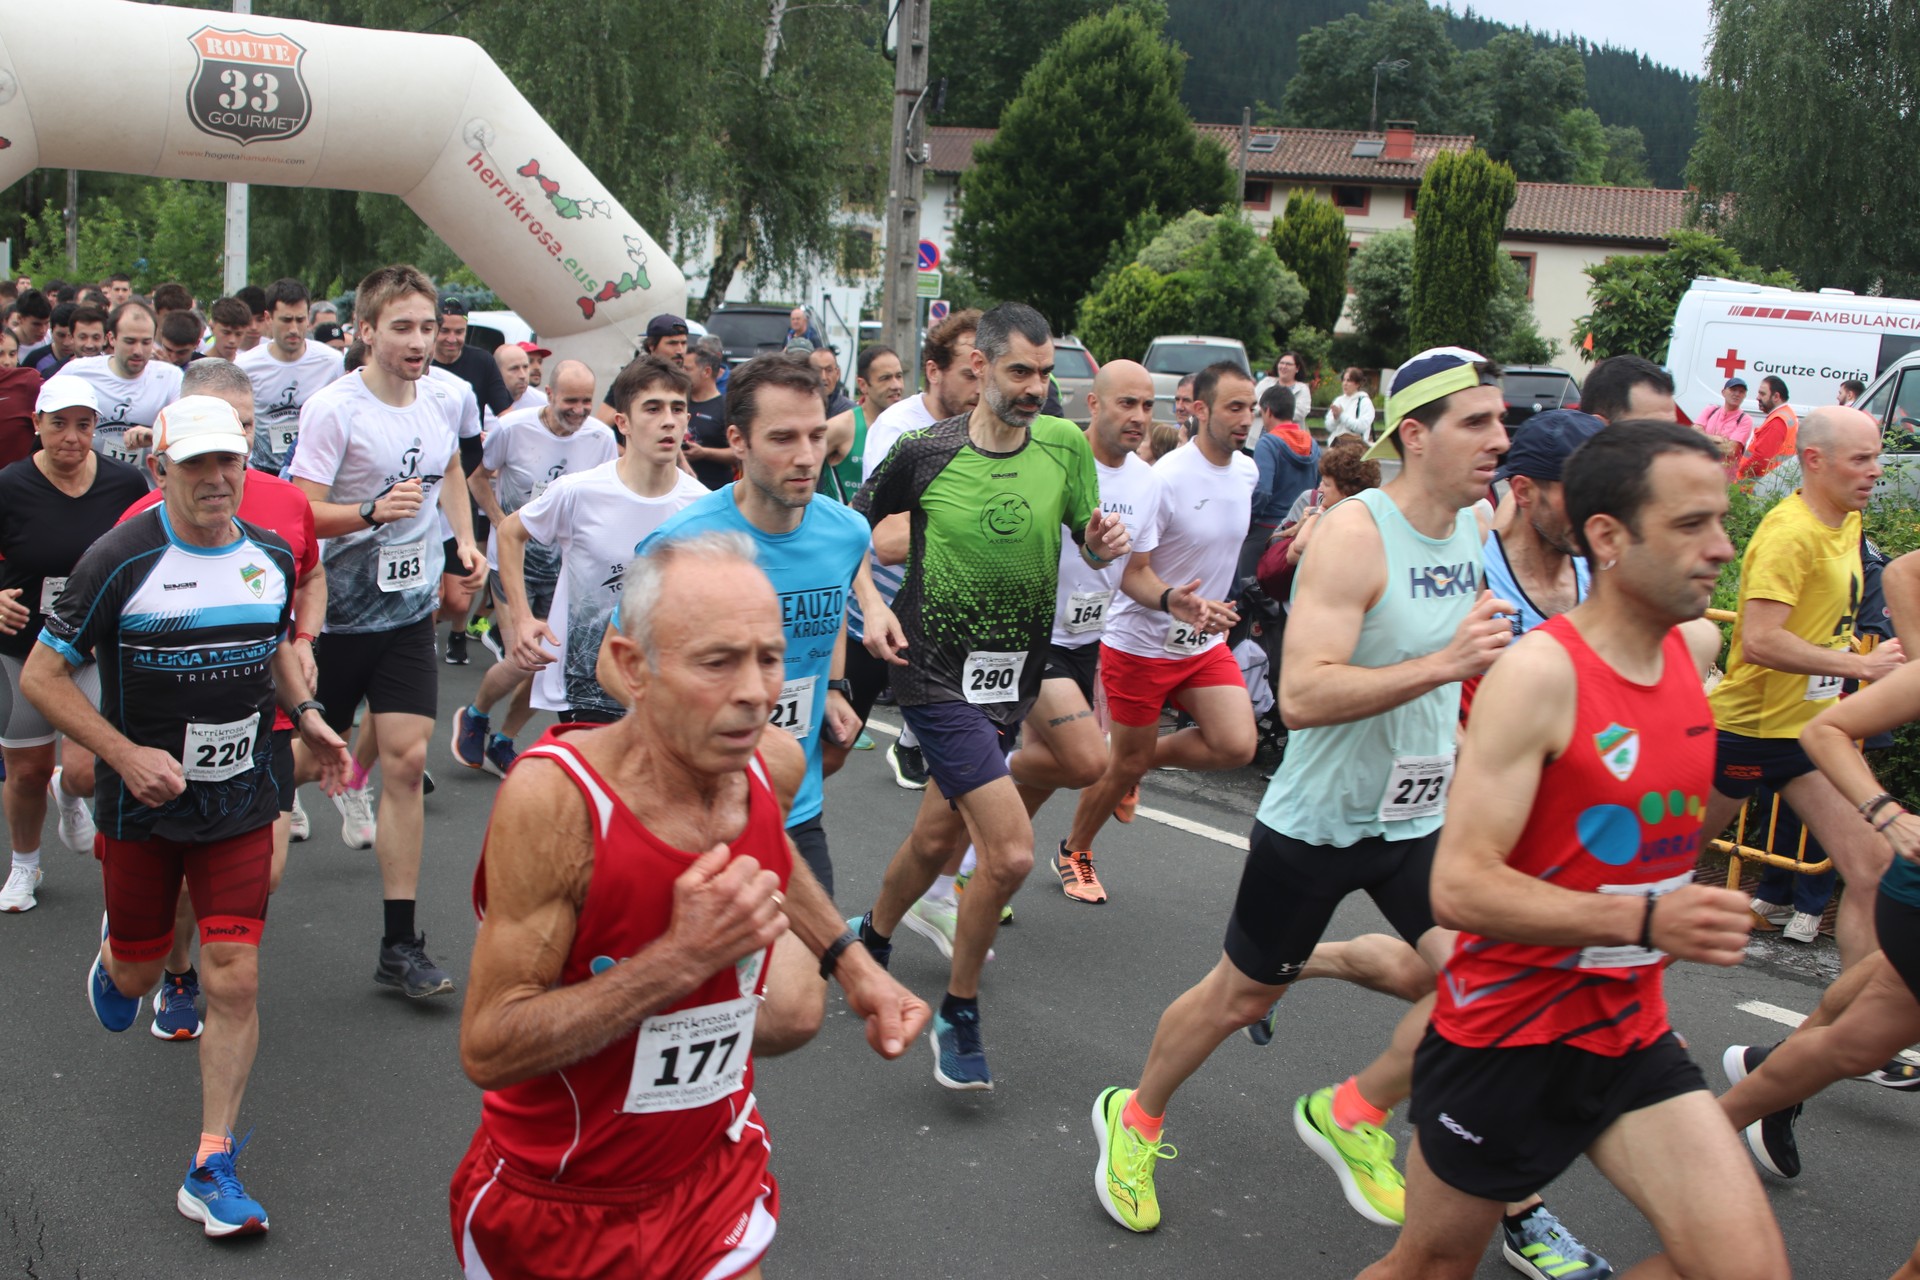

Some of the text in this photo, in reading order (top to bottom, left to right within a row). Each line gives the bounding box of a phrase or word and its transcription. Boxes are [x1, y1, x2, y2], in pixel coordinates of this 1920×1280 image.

[205, 37, 291, 63] ROUTE
[218, 69, 279, 113] 33
[208, 111, 300, 131] GOURMET
[467, 152, 599, 293] herrikrosa.eus
[1753, 361, 1869, 381] Gurutze Gorria
[1103, 502, 1133, 515] LANA
[387, 557, 420, 581] 183
[1410, 561, 1477, 599] HOKA
[1071, 605, 1104, 625] 164
[1173, 628, 1209, 646] 246
[133, 650, 203, 666] ALOÑA
[176, 663, 265, 682] TRIATLOIA
[971, 668, 1014, 690] 290
[196, 736, 251, 768] 220
[1393, 776, 1444, 805] 273
[653, 1031, 742, 1087] 177
